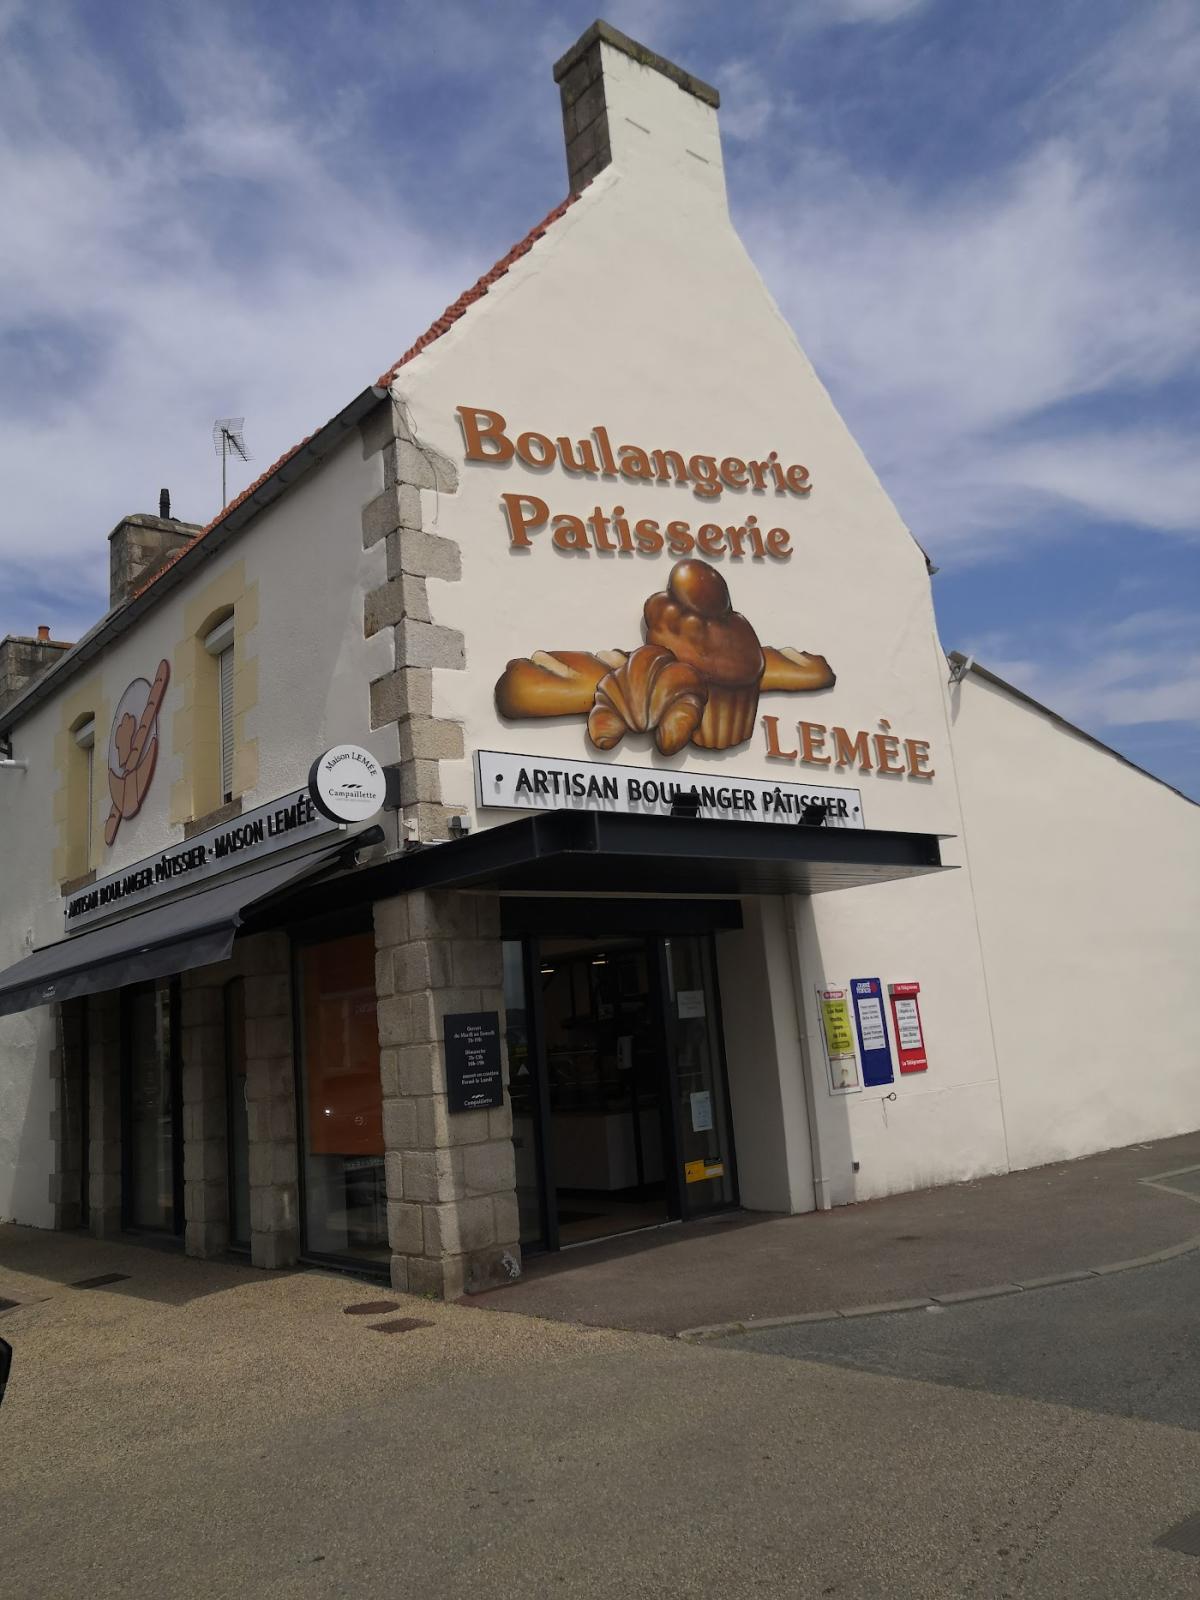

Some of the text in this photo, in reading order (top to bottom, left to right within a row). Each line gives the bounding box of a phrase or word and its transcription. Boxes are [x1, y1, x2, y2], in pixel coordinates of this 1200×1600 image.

[456, 405, 813, 497] Boulangerie
[501, 493, 794, 558] Patisserie
[325, 753, 350, 772] Maison
[515, 768, 619, 800] ARTISAN
[328, 788, 377, 799] Campaillette
[68, 890, 98, 919] ARTISAN
[100, 867, 154, 906] BOULANGER
[155, 845, 206, 882] PÂTISSIER
[214, 819, 264, 859] MAISON
